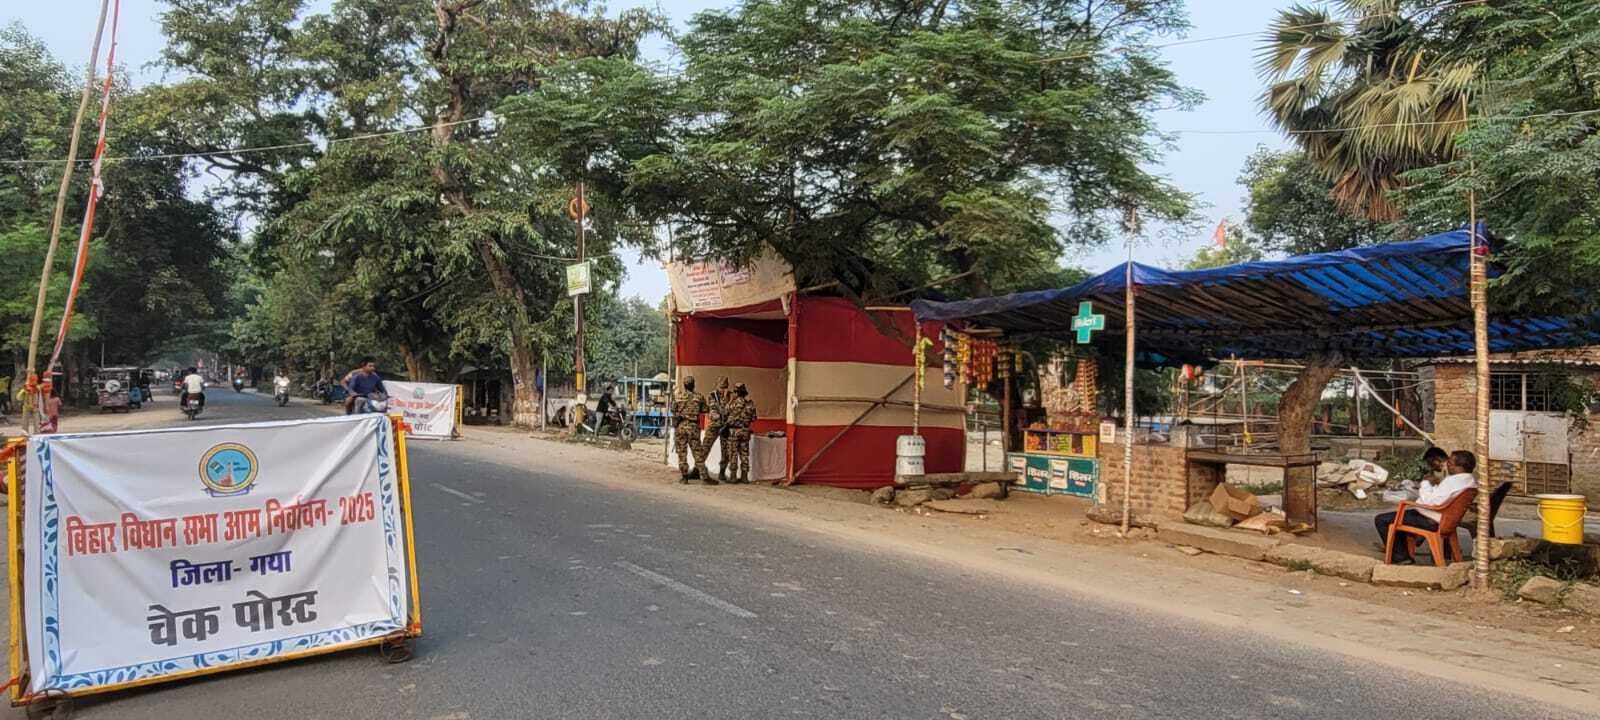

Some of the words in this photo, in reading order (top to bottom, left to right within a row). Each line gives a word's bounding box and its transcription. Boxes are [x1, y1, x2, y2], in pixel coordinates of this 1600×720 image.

[65, 515, 117, 556] बिहार
[121, 512, 178, 551] विधान
[182, 512, 219, 545] सभा
[223, 508, 261, 541] आम
[339, 492, 376, 525] 2025
[170, 559, 242, 588] जिला-
[249, 550, 292, 576] गया
[146, 604, 221, 646] चेक
[232, 590, 318, 632] पोस्ट
